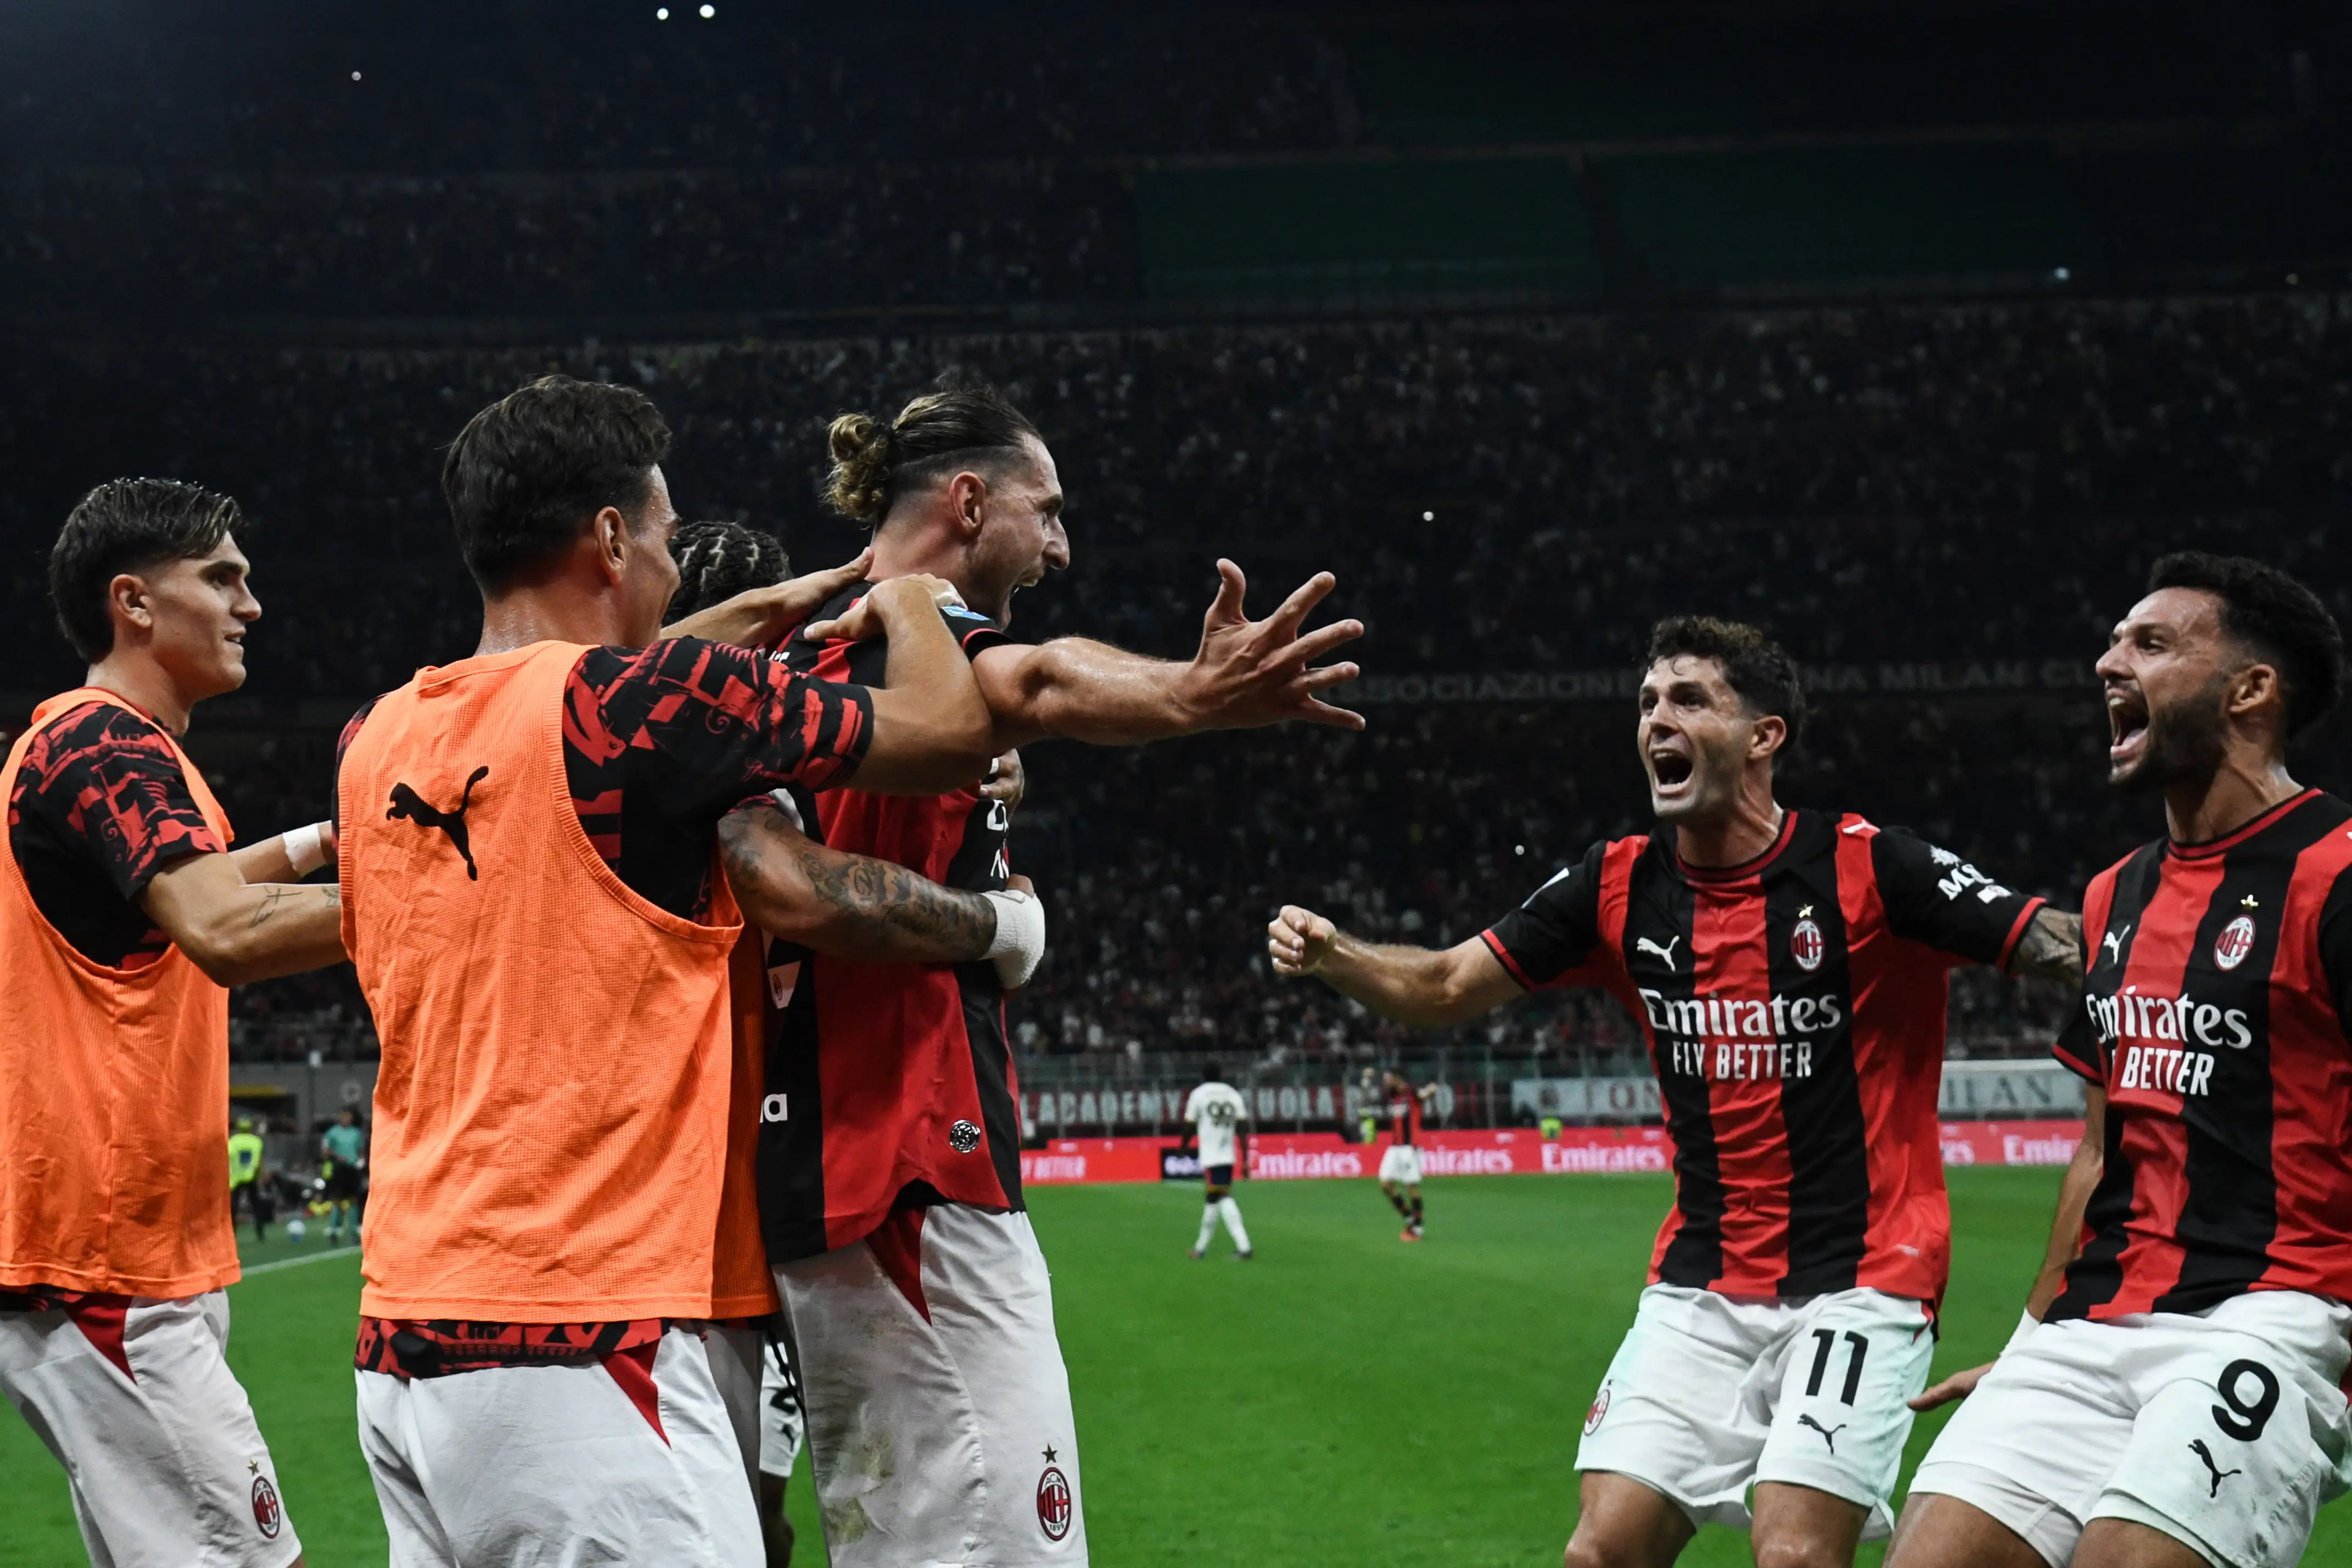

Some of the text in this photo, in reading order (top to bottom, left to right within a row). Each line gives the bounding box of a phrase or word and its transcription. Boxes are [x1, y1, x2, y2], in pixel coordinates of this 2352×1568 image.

[1320, 669, 1640, 704] SSOCIAZIONE
[1638, 988, 1841, 1037] Emirates
[2086, 985, 2252, 1049] Emirates
[1672, 1041, 1812, 1080] FLY BETTER
[2120, 1046, 2215, 1096] BETTER
[1420, 1145, 1514, 1176] mirates
[1806, 1329, 1869, 1407] 11
[2211, 1359, 2280, 1442] 9
